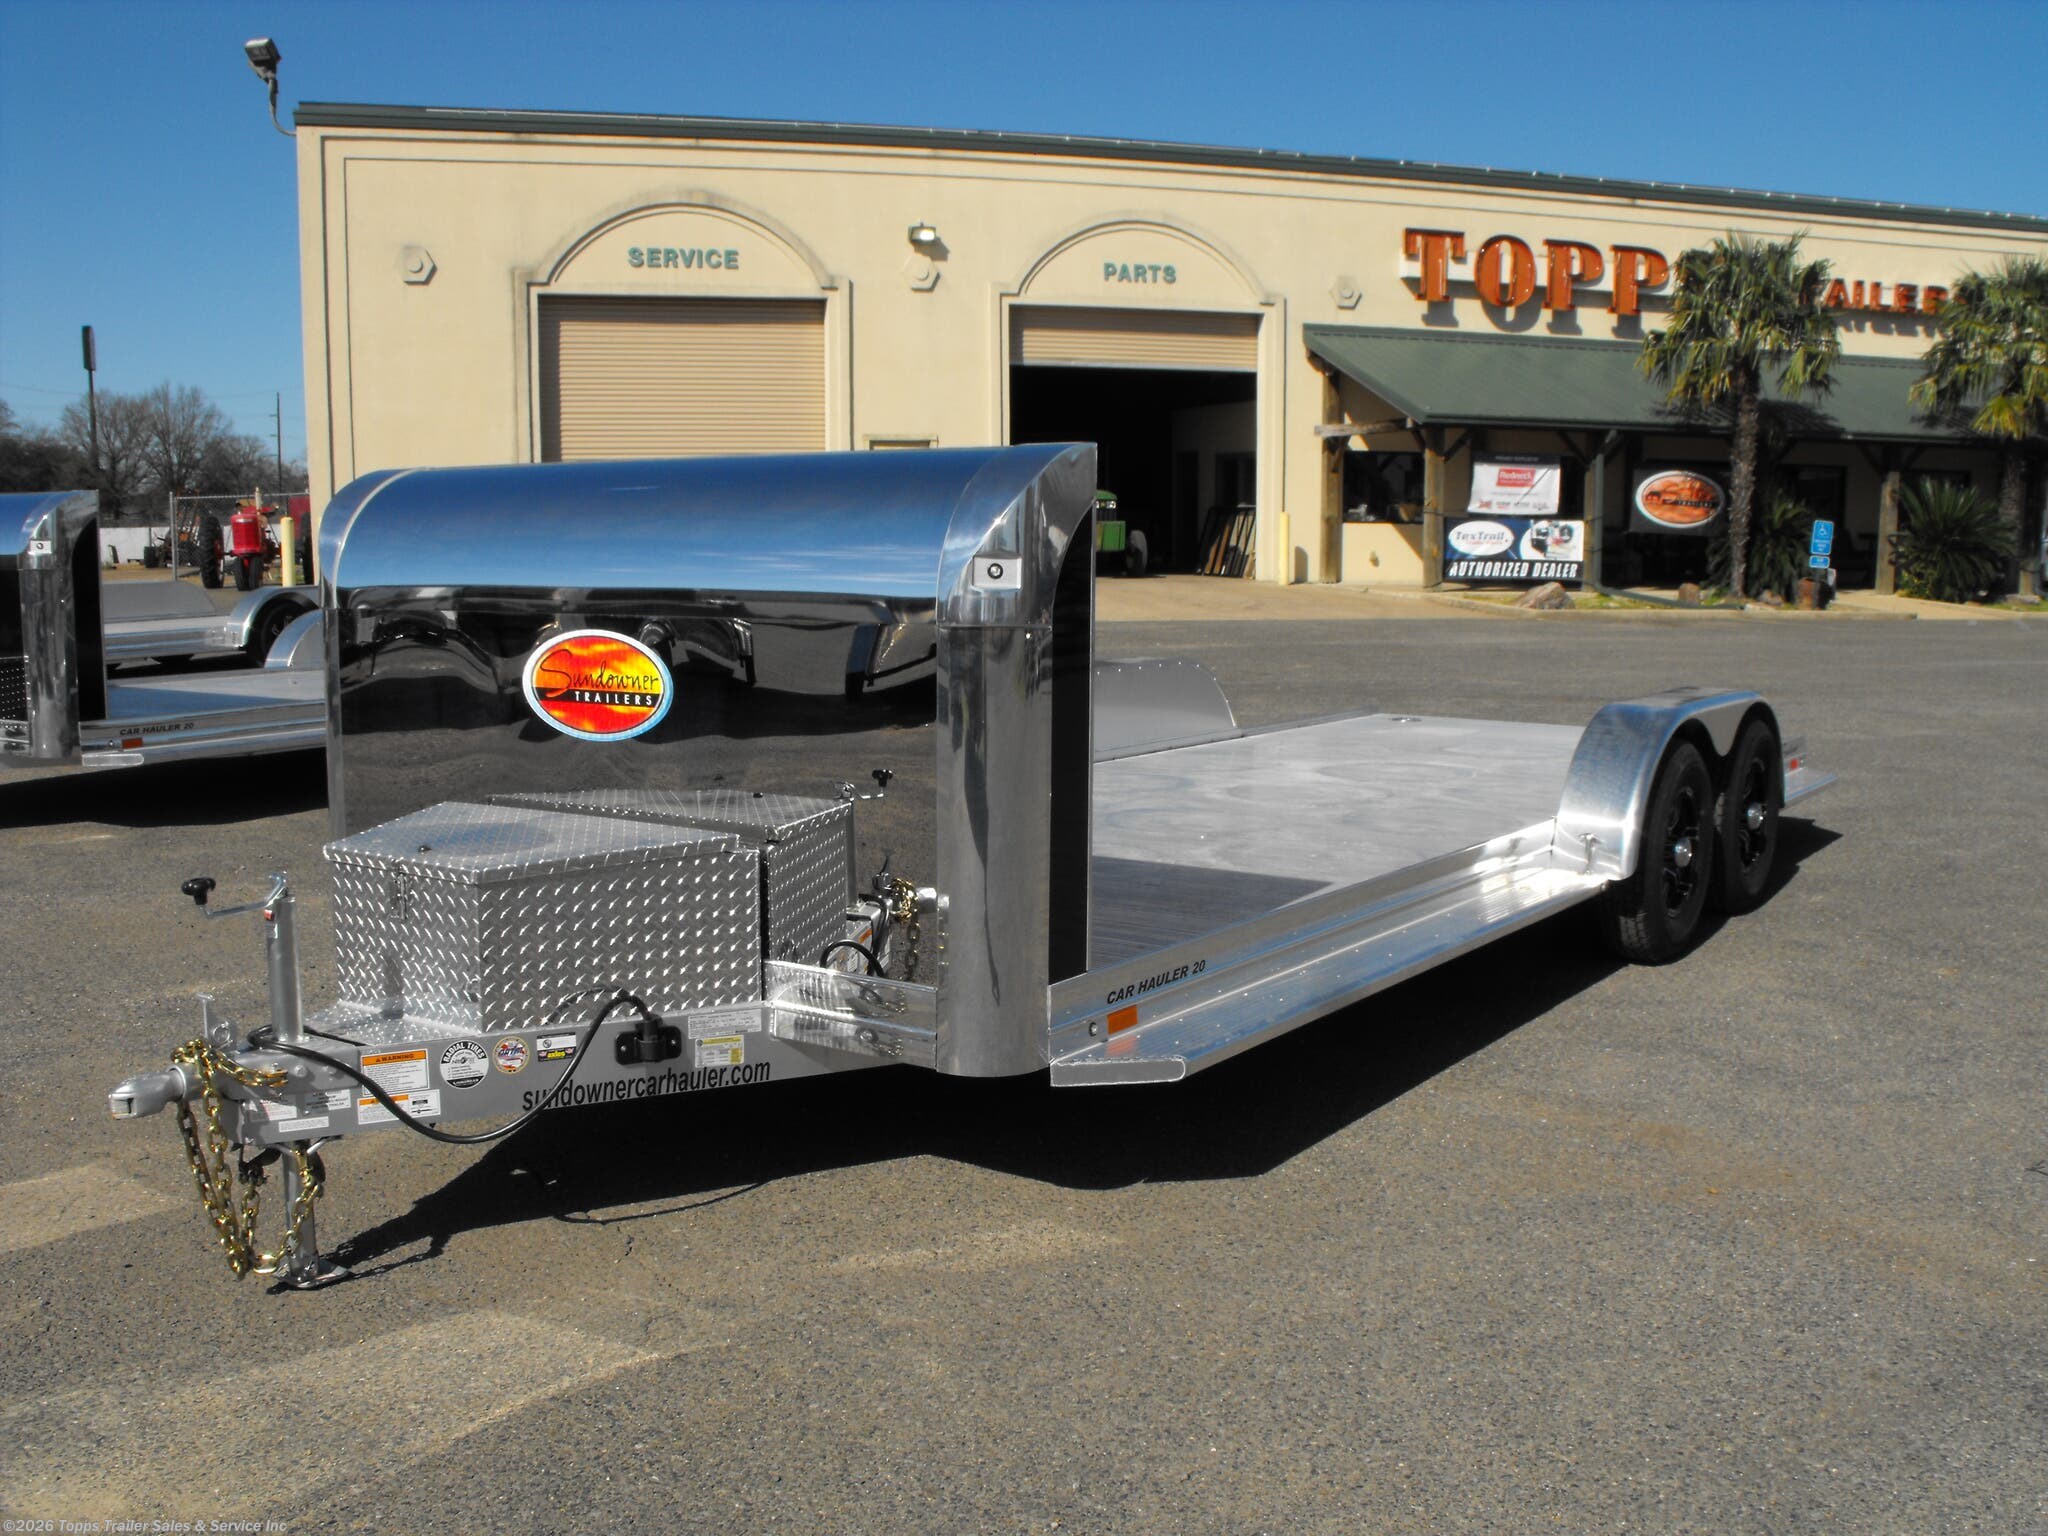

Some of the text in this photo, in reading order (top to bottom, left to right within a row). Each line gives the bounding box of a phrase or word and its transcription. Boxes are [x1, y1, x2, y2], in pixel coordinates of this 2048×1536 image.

[628, 247, 740, 270] SERVICE
[1104, 262, 1176, 284] PARTS
[1403, 228, 1671, 315] TOPP
[1820, 277, 1950, 315] AILER
[1449, 562, 1578, 578] AUTHORIZED DEALER
[540, 649, 659, 698] Sundowner
[575, 691, 653, 706] TRAILERS
[1107, 959, 1206, 1005] CAR HAULER 20
[443, 1042, 465, 1063] RADIAL
[467, 1042, 486, 1059] TIRES
